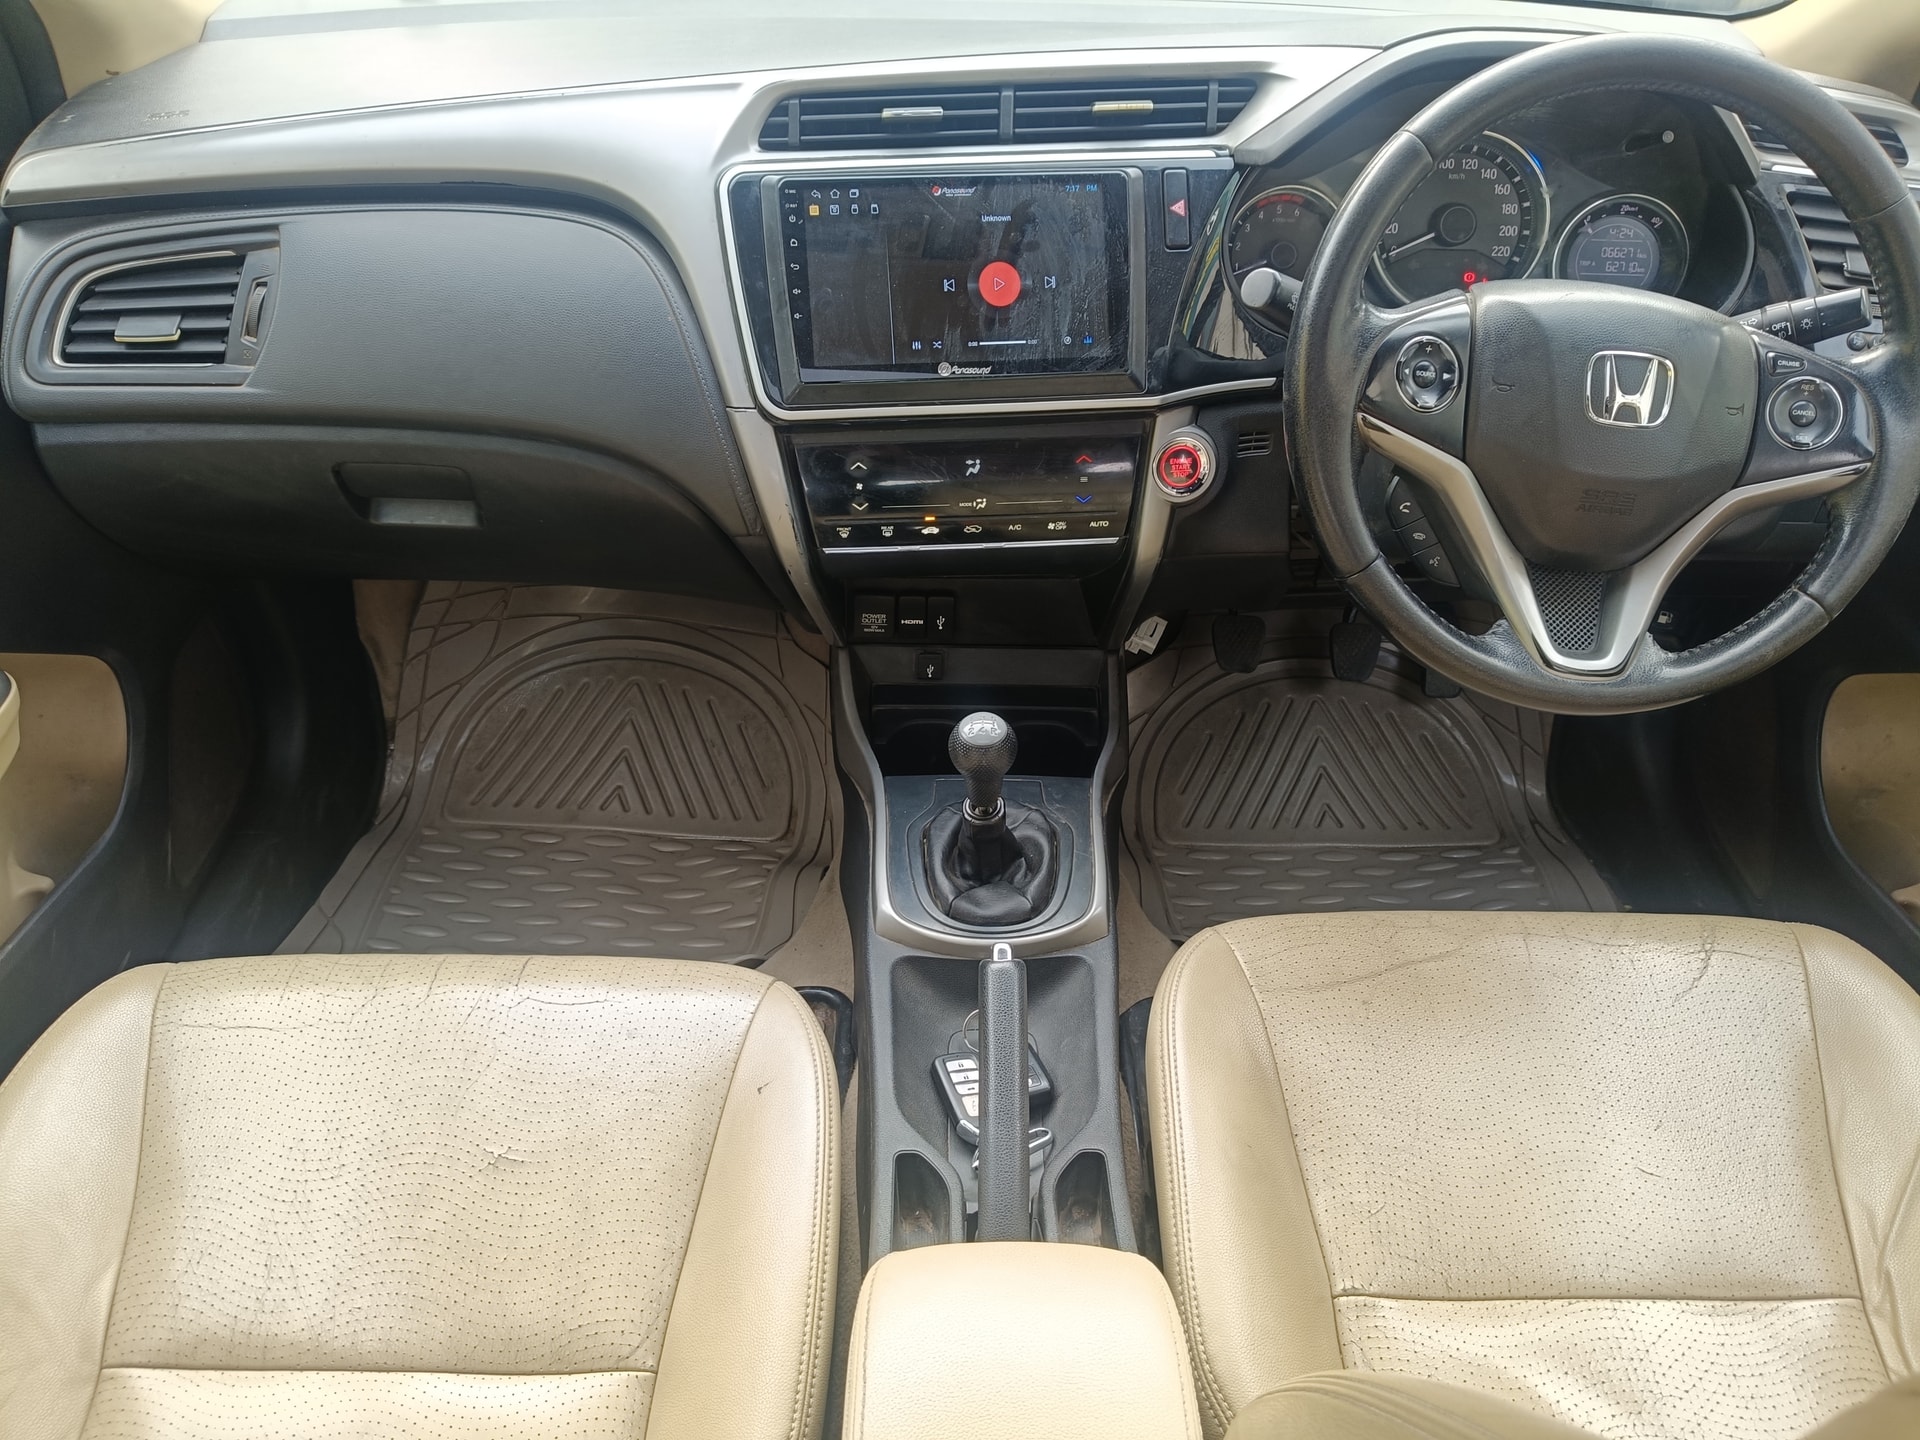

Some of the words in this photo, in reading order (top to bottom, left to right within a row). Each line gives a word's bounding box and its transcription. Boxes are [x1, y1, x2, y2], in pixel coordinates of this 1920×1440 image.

[1462, 158, 1478, 170] 120
[1481, 168, 1498, 179] 140
[1065, 184, 1080, 193] 7:17
[1086, 184, 1098, 192] PM
[1494, 184, 1511, 195] 160
[1276, 205, 1282, 214] 5
[1294, 207, 1300, 217] 6
[1502, 204, 1518, 215] 180
[981, 214, 1012, 223] Unknown
[1258, 211, 1264, 219] 4
[1245, 224, 1251, 232] 3
[1499, 226, 1518, 236] 200
[1236, 242, 1241, 251] 2
[1491, 247, 1511, 257] 220
[1771, 321, 1786, 331] OFF
[1777, 359, 1800, 367] CRUISE
[1792, 409, 1815, 417] CANCEL
